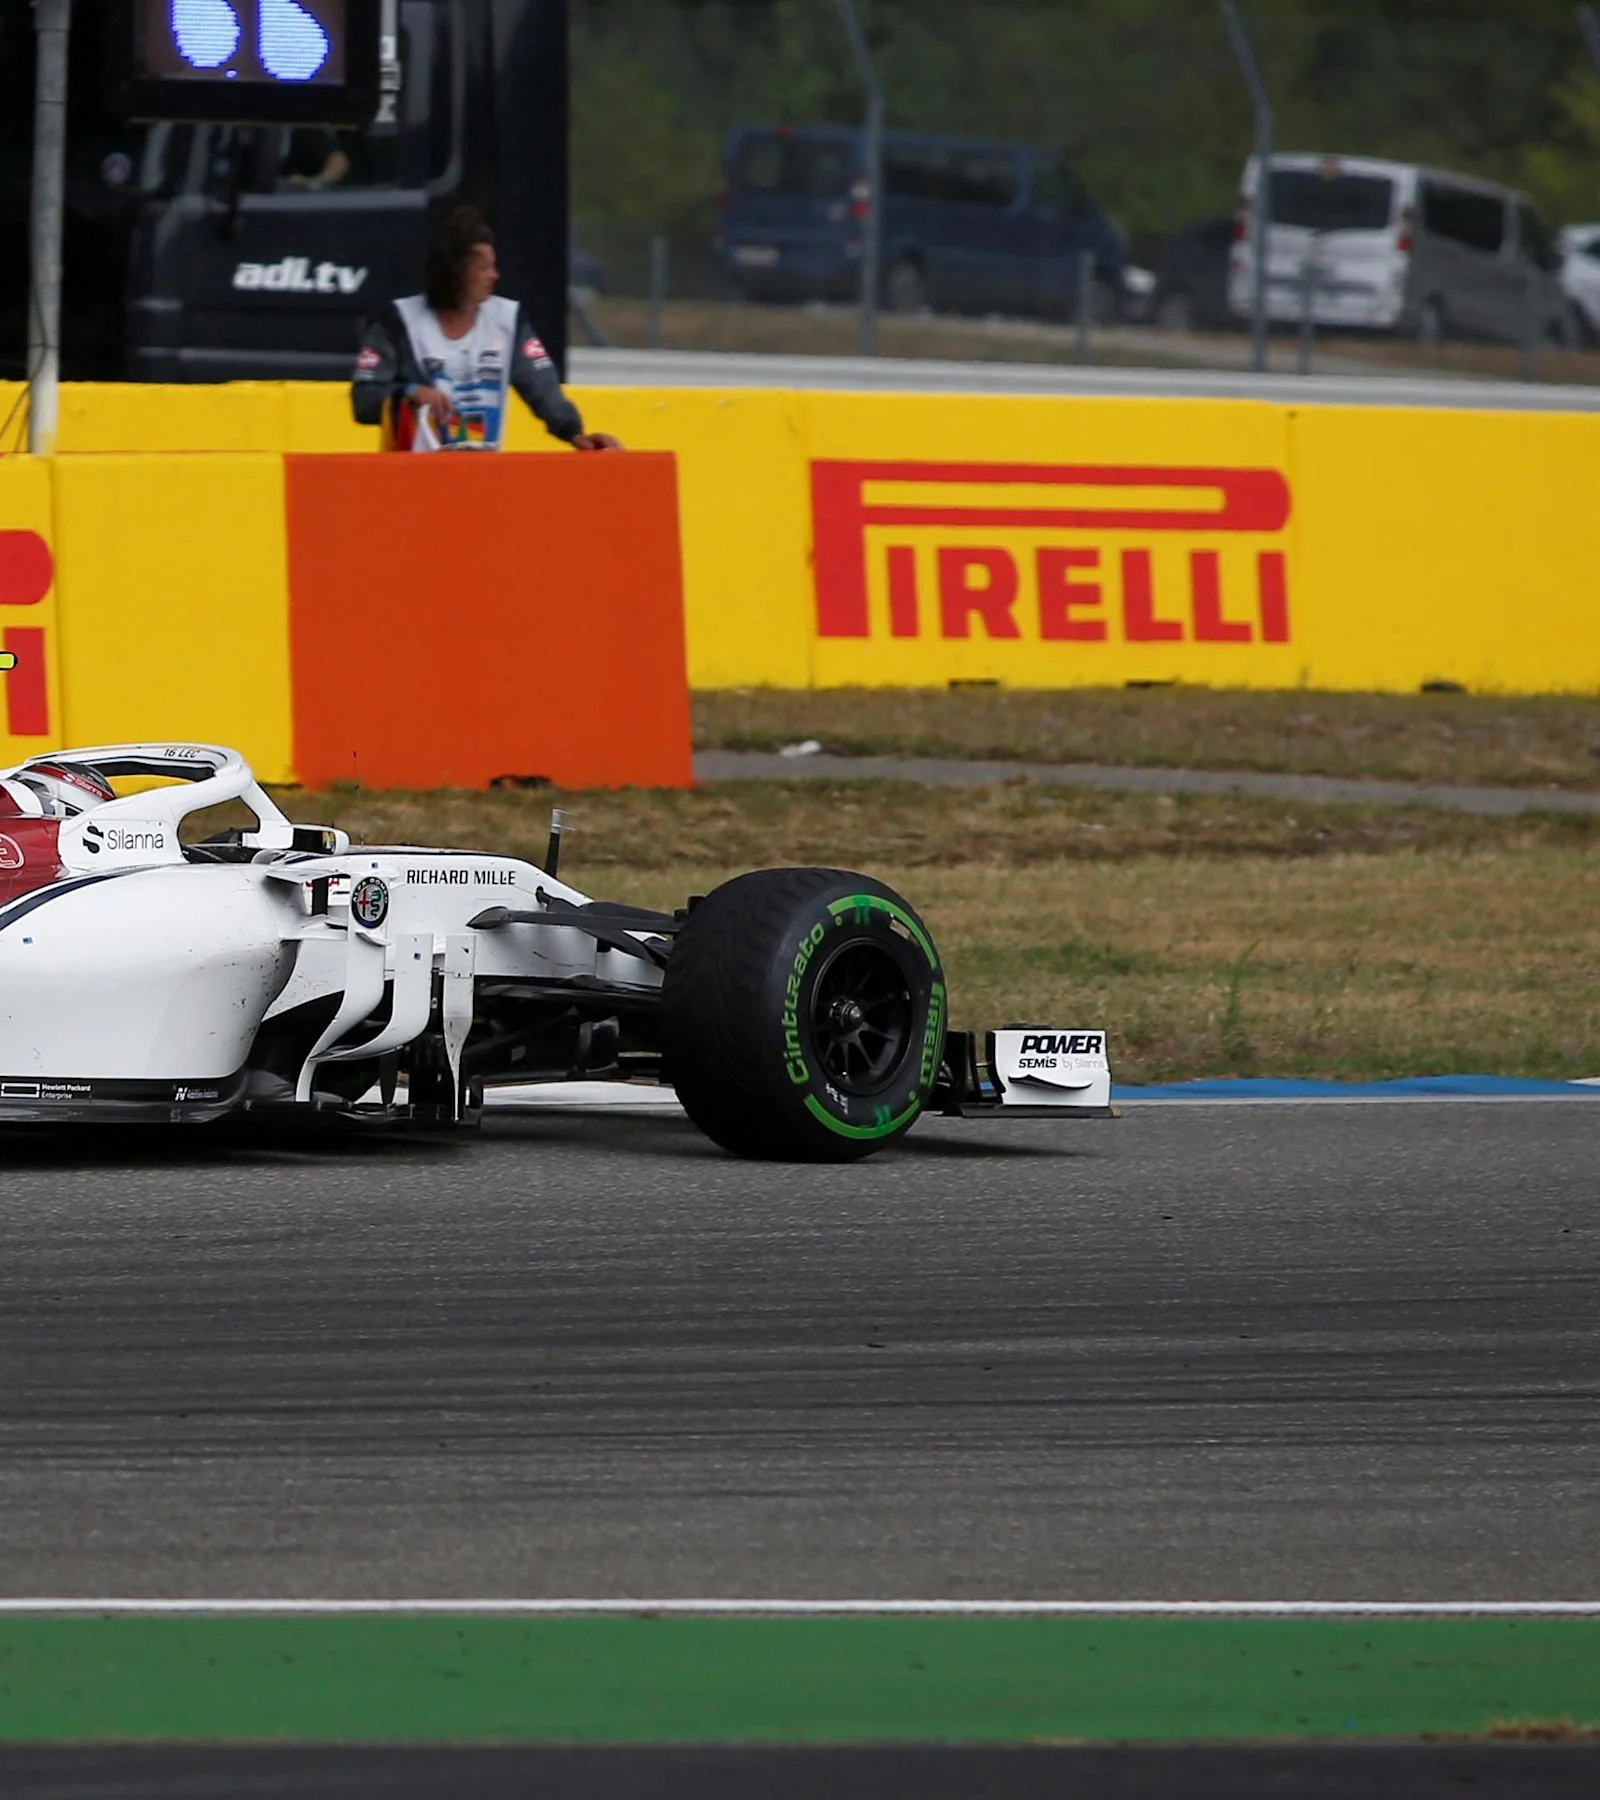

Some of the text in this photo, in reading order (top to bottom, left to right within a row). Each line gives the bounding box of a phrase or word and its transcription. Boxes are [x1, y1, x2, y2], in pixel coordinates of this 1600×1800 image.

[809, 459, 1292, 643] PIRELLI
[107, 829, 164, 850] Silanna
[407, 869, 517, 885] RICHARD MILLE
[782, 922, 825, 1085] Cinturato
[920, 981, 946, 1088] PIRELLI
[1020, 1035, 1102, 1054] POWER
